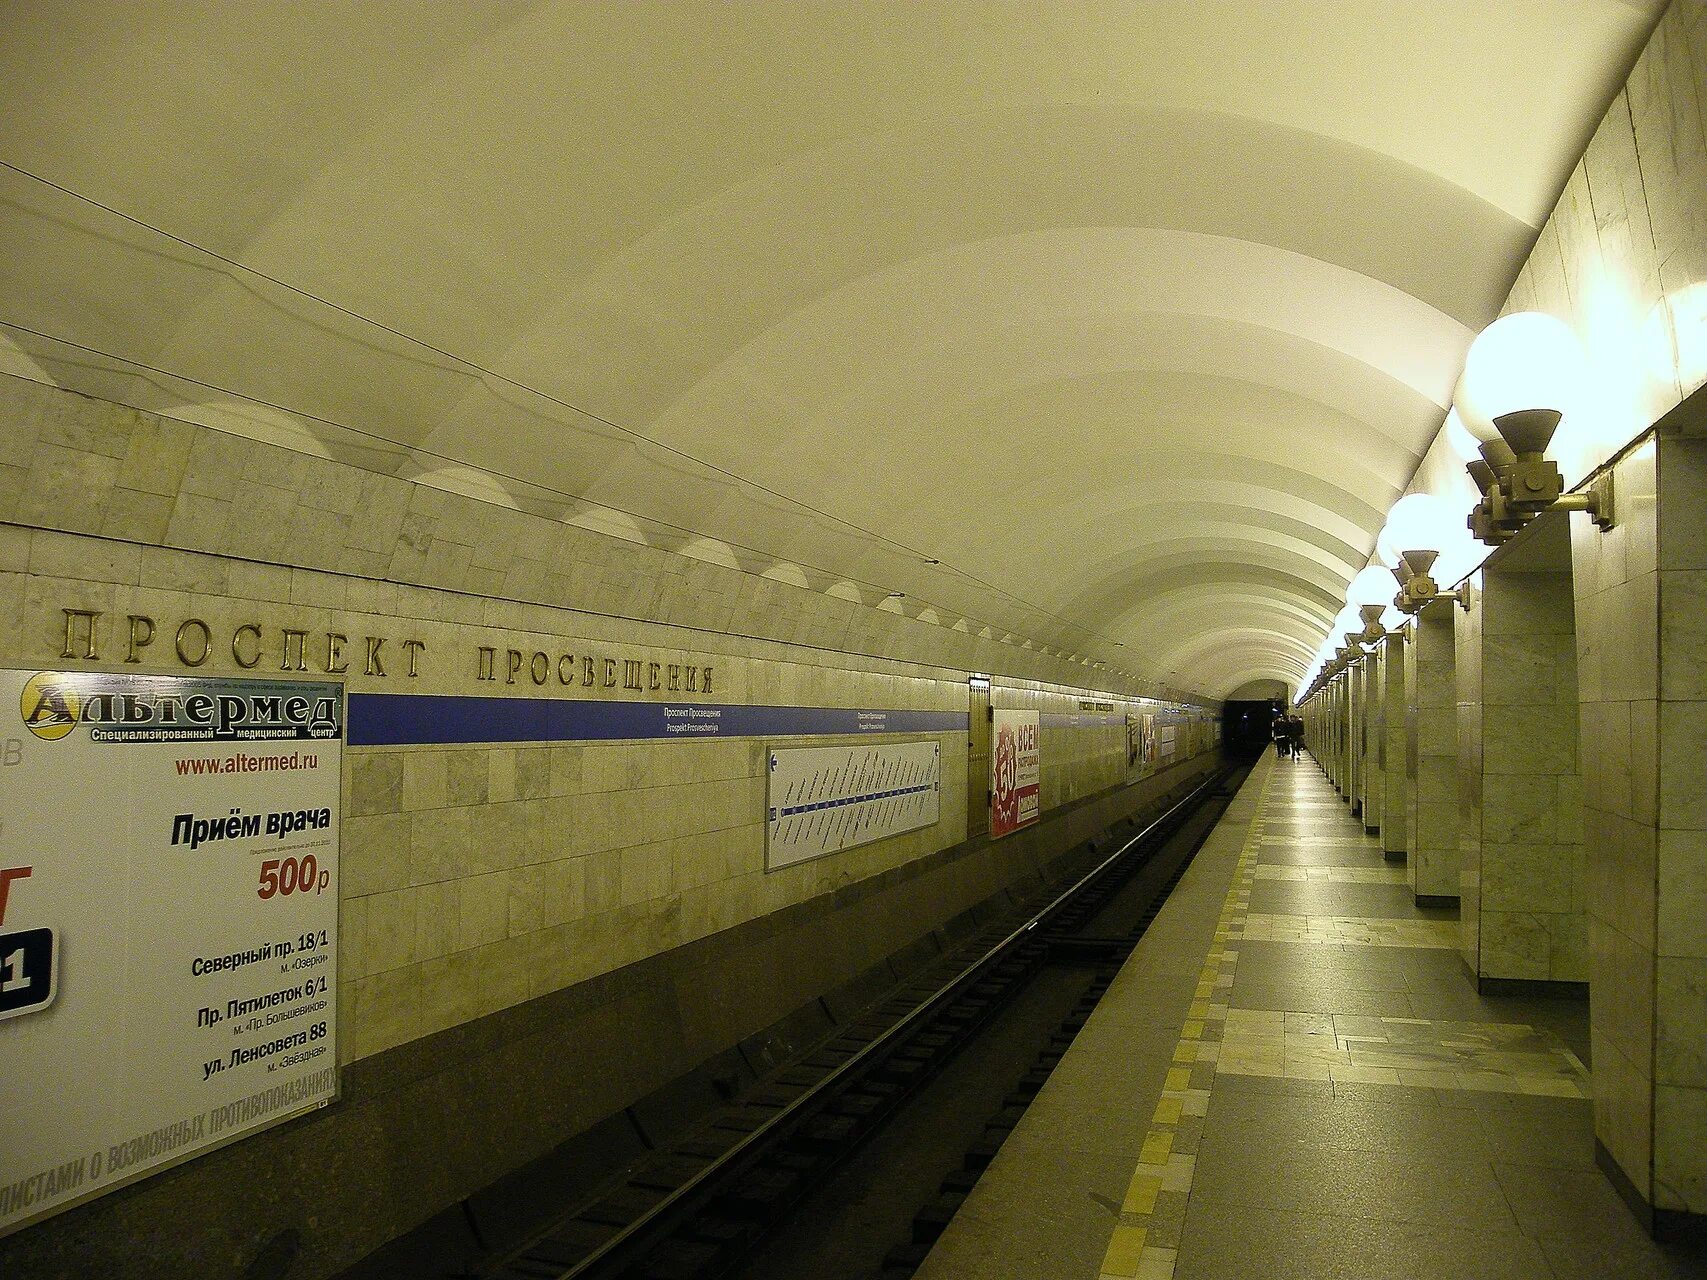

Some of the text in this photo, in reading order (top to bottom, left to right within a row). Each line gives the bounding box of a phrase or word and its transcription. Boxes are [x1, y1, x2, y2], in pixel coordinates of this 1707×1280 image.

[61, 608, 714, 694] ПРОСПЕКТ ПРОСВЕЩЕНИЯ
[25, 684, 339, 734] Альтермед
[664, 707, 689, 719] Проспект
[91, 726, 335, 742] Специализированный медицинский центр
[175, 751, 318, 776] www.altermed.ru
[171, 807, 331, 850] Приём врача
[257, 853, 330, 900] 500р
[191, 929, 329, 977] Северный пр. 18/1
[280, 963, 290, 974] м.
[197, 975, 328, 1028] Пр. Пятилеток 6/1
[266, 1000, 328, 1026] Большевиков»
[202, 1021, 327, 1081] ул. Ленсовета 88
[107, 1112, 206, 1175] ВОЗМОЖНЫХ
